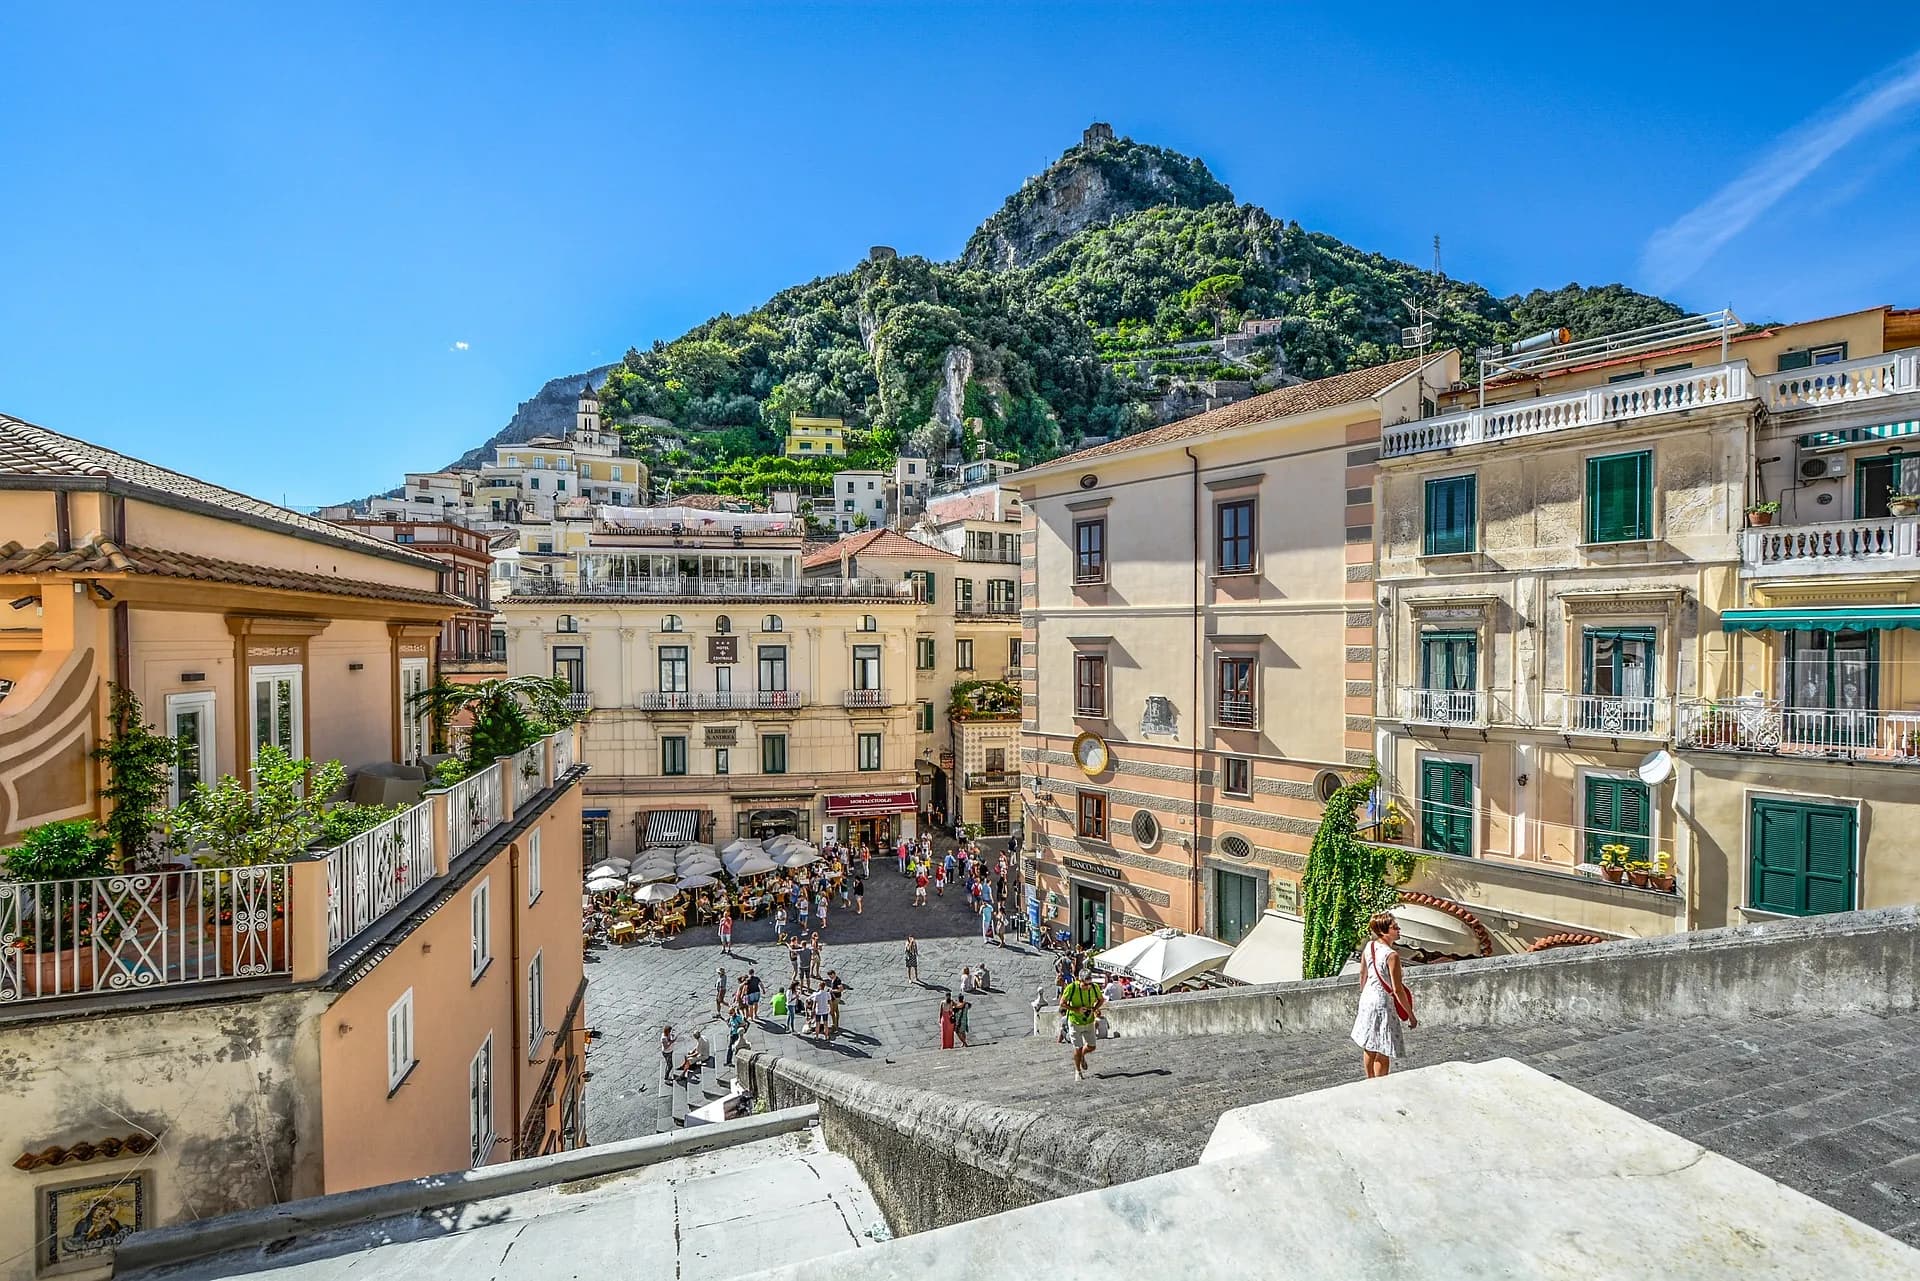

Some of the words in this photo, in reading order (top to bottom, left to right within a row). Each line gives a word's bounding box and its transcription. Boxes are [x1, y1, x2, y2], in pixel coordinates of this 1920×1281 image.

[1071, 860, 1092, 871] BANCO
[1097, 866, 1119, 878] NAPOLI
[1097, 961, 1115, 972] LIGHT
